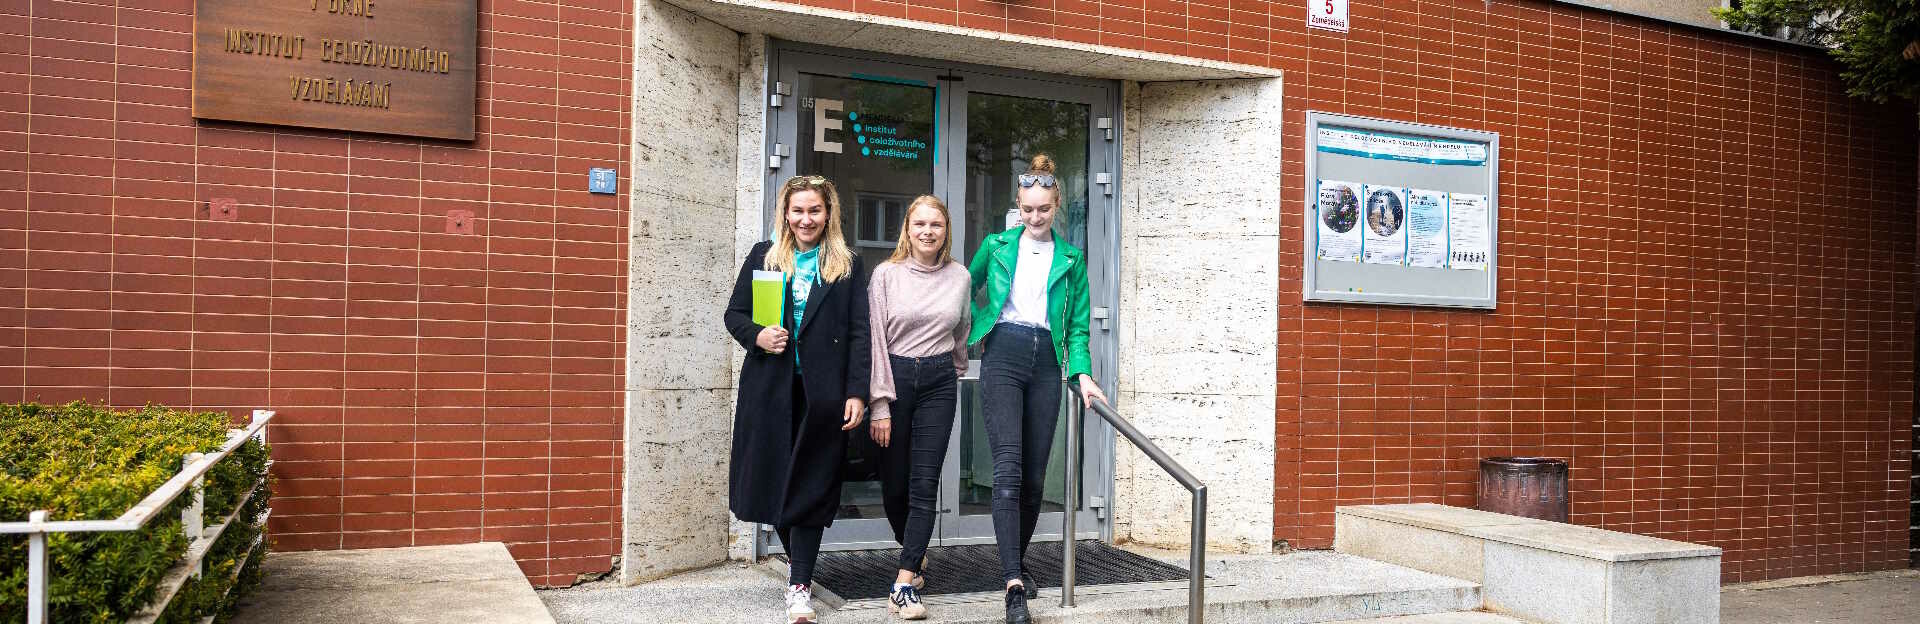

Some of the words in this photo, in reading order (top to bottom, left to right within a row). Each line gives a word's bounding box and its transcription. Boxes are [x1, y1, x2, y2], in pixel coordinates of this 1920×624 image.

[1325, 0, 1334, 15] 5
[224, 27, 305, 60] INSTITUT
[320, 38, 449, 74] CELOŽIVOTNÍHO
[289, 72, 392, 110] VZDĚLÁVÁNÍ
[814, 98, 844, 154] E
[1319, 129, 1350, 139] INST
[869, 136, 926, 149] celoživotního
[873, 148, 918, 159] vzdělávání
